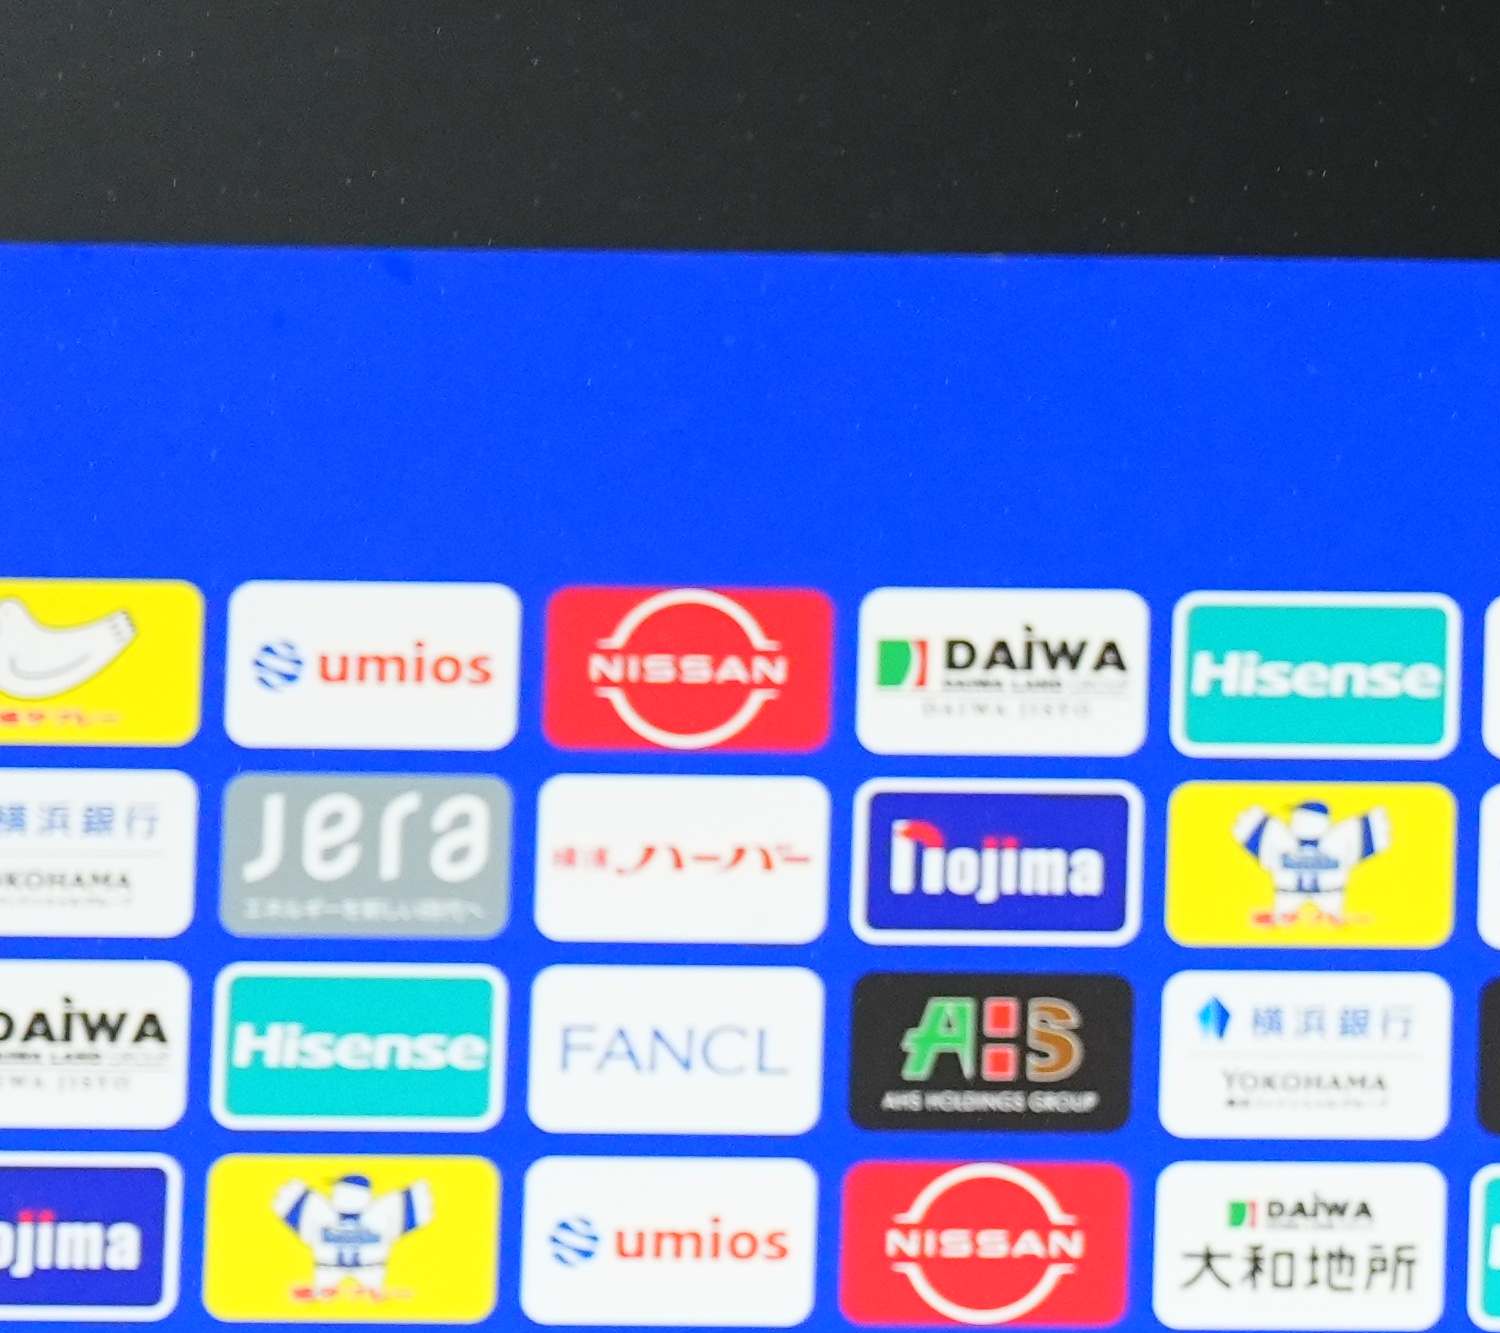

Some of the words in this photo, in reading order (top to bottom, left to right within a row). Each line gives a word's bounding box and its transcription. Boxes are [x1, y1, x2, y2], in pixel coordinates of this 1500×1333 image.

[319, 642, 492, 684] umios
[589, 653, 787, 684] NISSAN
[1194, 653, 1441, 696] Hisense
[1251, 1006, 1411, 1038] 横浜銀行
[235, 1025, 495, 1069] Hisense
[559, 1024, 787, 1075] FANCL
[616, 1217, 789, 1260] umios
[886, 1229, 1084, 1258] NISSAN
[1184, 1244, 1416, 1291] 大和地所
